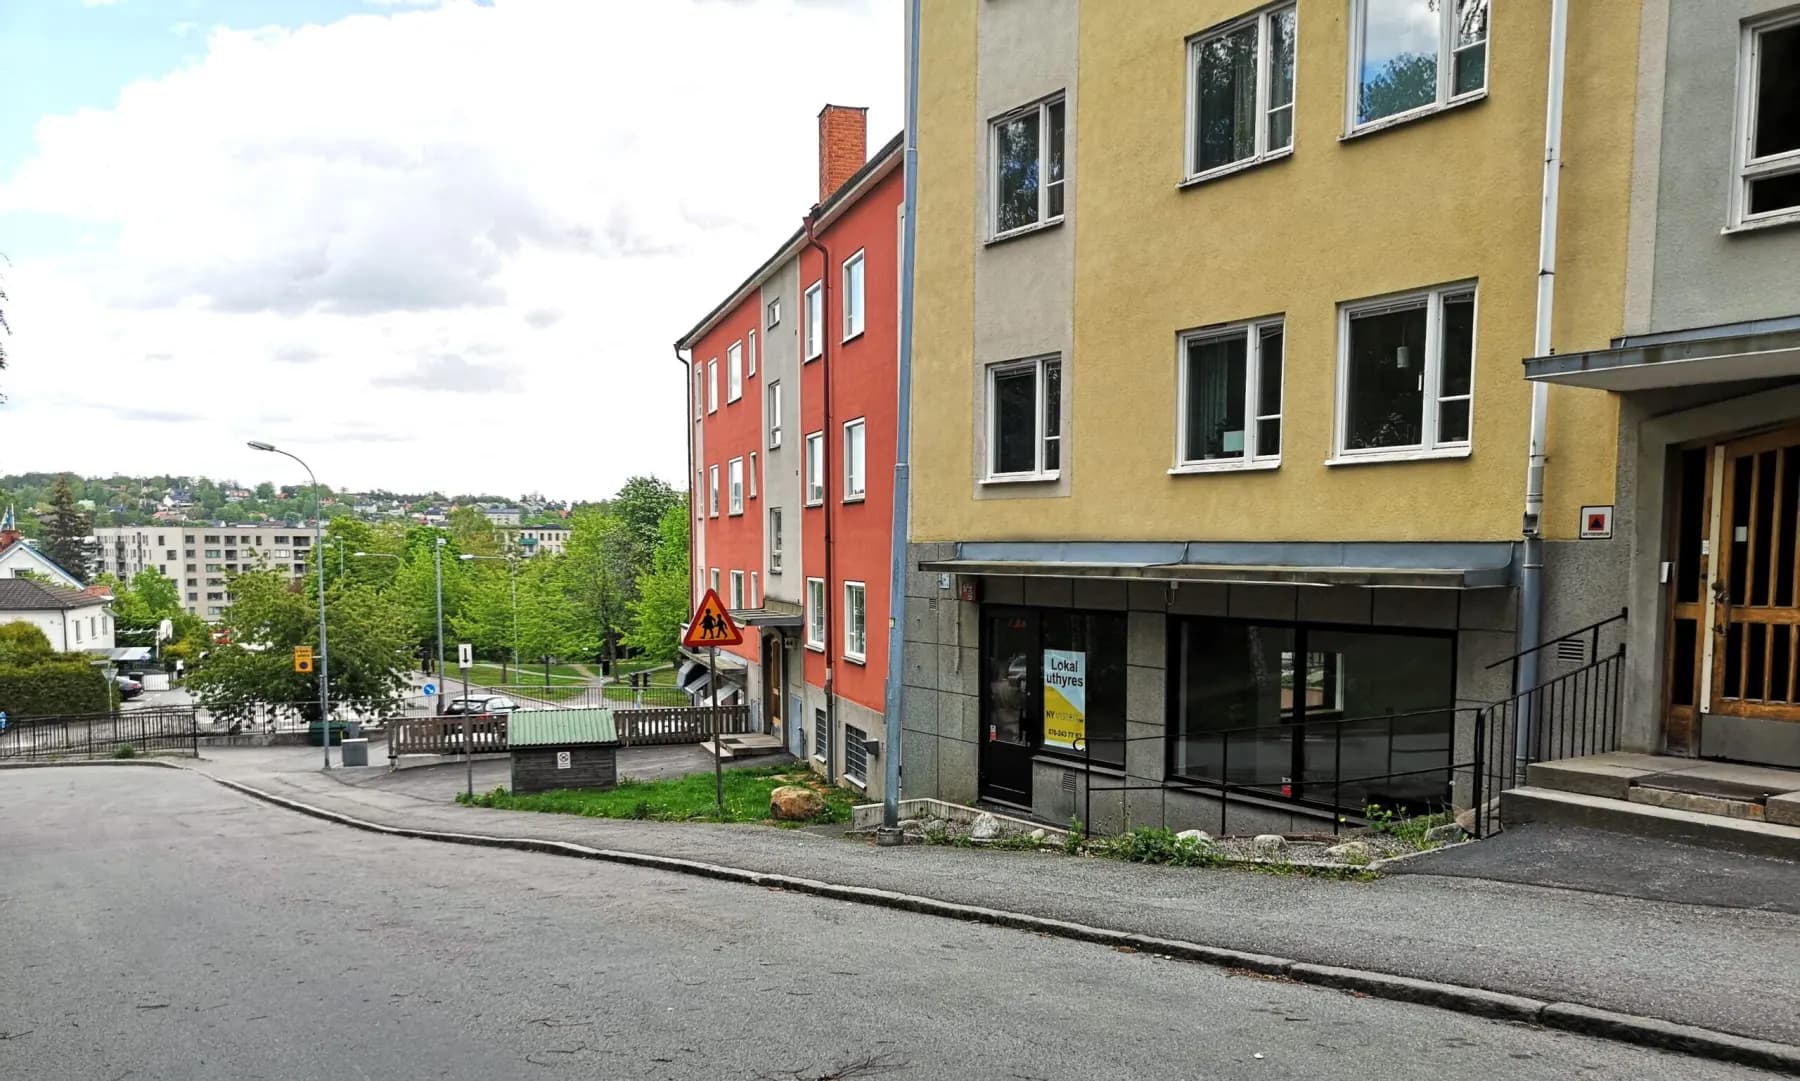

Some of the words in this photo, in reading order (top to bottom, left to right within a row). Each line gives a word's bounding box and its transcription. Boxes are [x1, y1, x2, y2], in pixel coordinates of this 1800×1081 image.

[1051, 658, 1078, 673] Lokal
[1046, 672, 1084, 688] uthyres
[1046, 710, 1055, 719] NY
